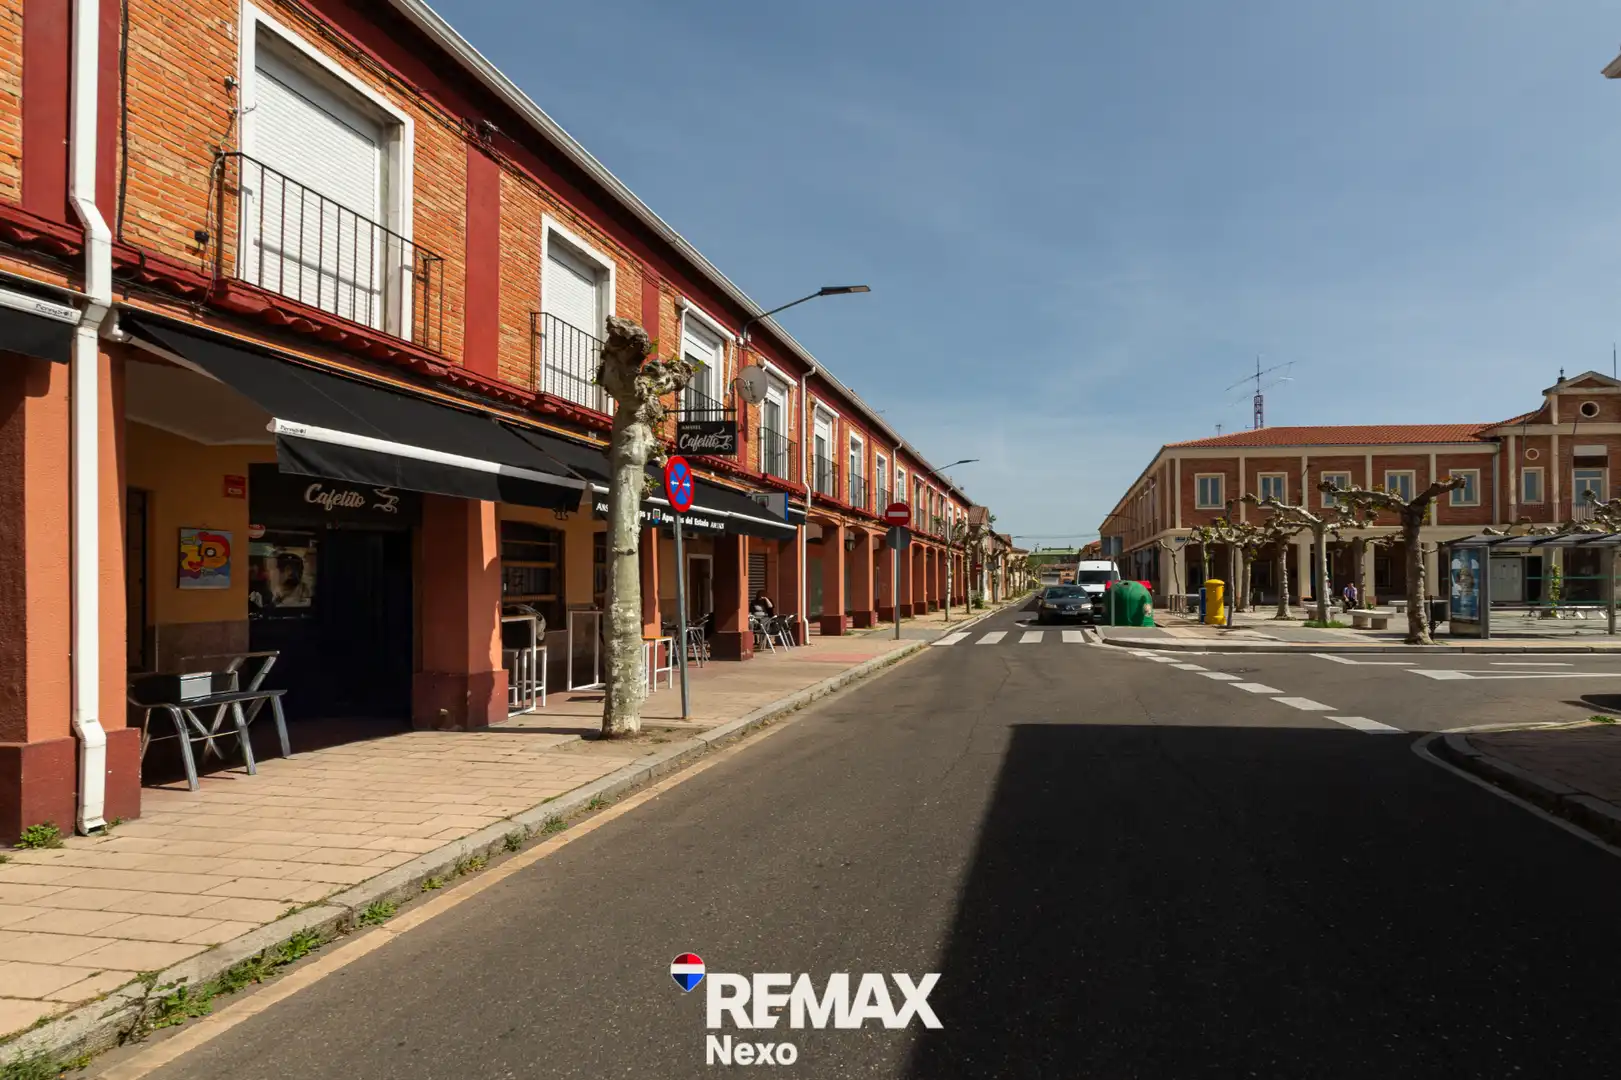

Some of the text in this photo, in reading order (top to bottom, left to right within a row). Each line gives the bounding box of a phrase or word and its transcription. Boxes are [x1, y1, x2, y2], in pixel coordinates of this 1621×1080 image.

[680, 433, 720, 452] Cafelito
[304, 483, 366, 511] Cafelito
[694, 518, 709, 527] Estado
